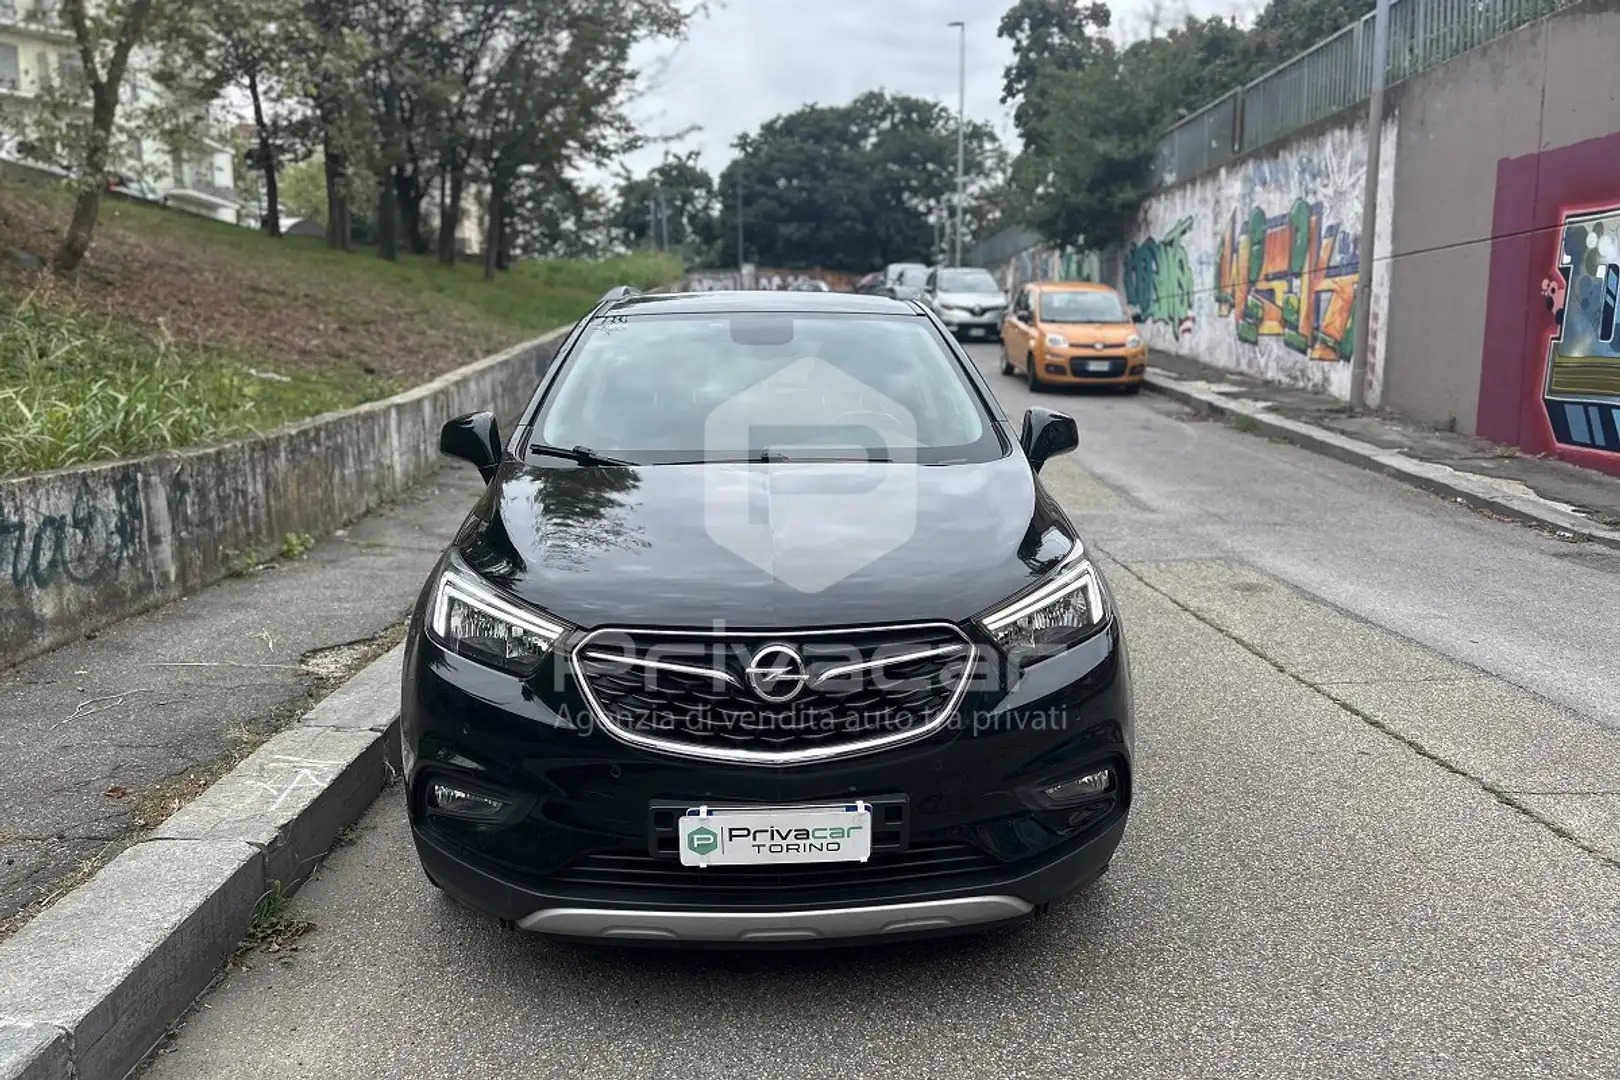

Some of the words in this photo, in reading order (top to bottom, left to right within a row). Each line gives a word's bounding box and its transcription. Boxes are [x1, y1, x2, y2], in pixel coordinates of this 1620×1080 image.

[693, 834, 713, 848] P
[728, 826, 863, 843] Privacar
[752, 842, 841, 855] TORINO
